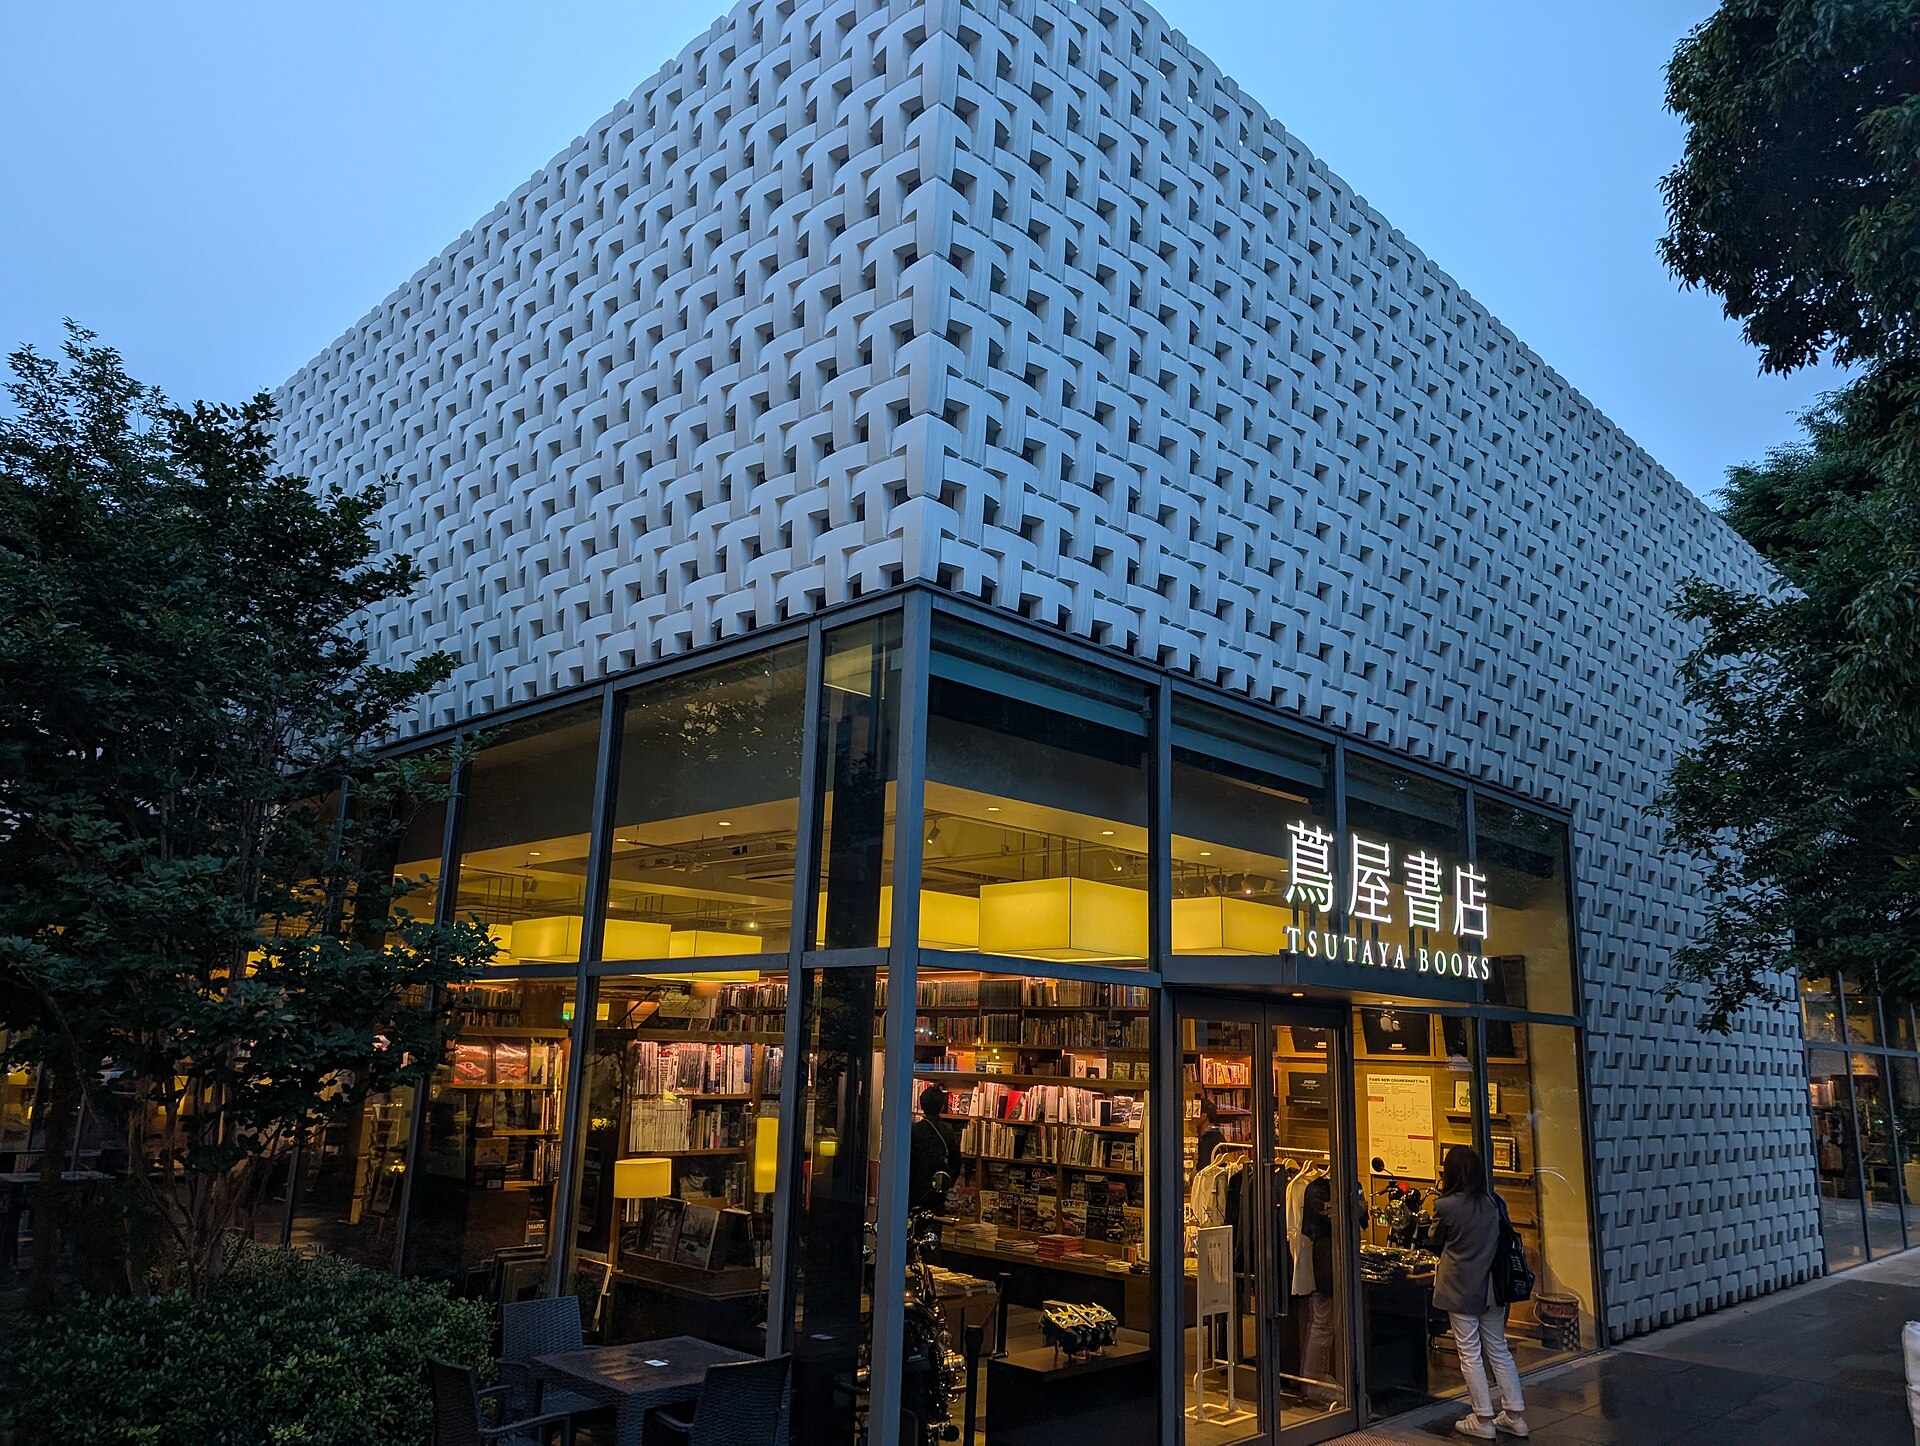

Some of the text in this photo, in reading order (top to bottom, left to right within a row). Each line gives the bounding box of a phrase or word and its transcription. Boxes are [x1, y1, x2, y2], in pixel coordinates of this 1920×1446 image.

[1285, 820, 1488, 940] 蔦屋書店
[1286, 926, 1490, 981] TSUTAYA BOOKS
